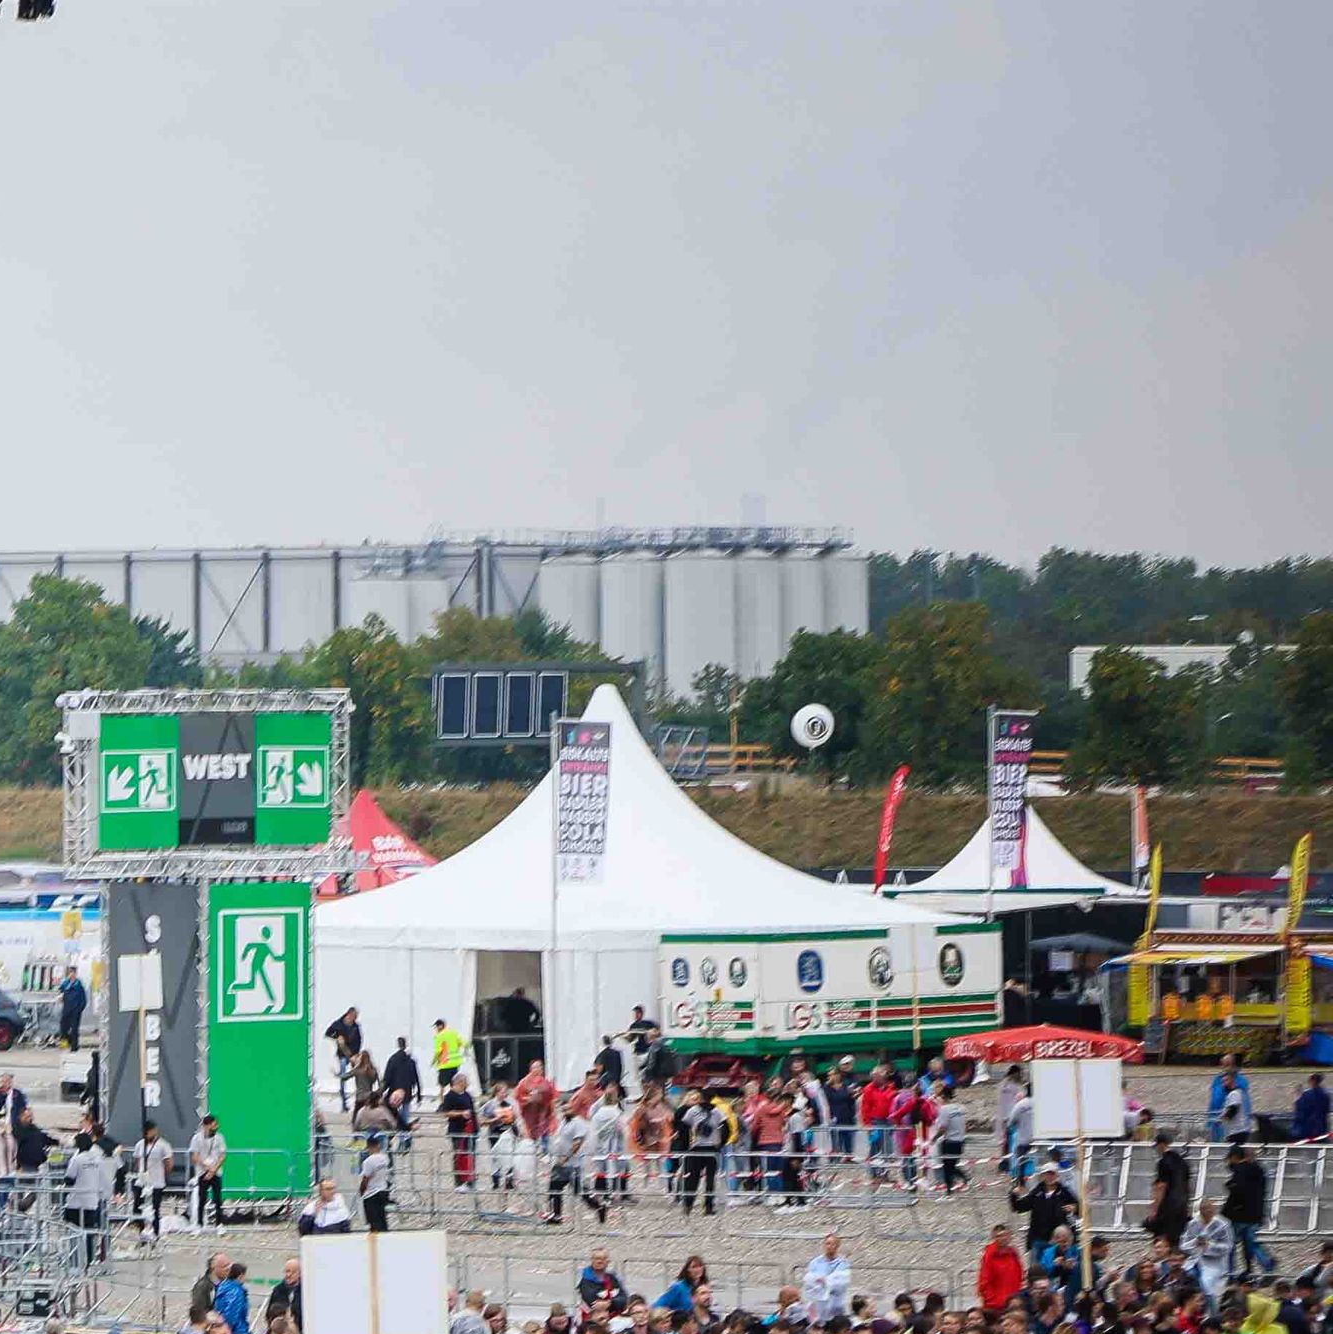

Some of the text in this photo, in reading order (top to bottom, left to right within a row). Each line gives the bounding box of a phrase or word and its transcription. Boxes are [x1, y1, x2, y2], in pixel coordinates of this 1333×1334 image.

[182, 753, 251, 780] WEST
[144, 915, 162, 1107] SBER
[1035, 1039, 1096, 1058] BREZEL
